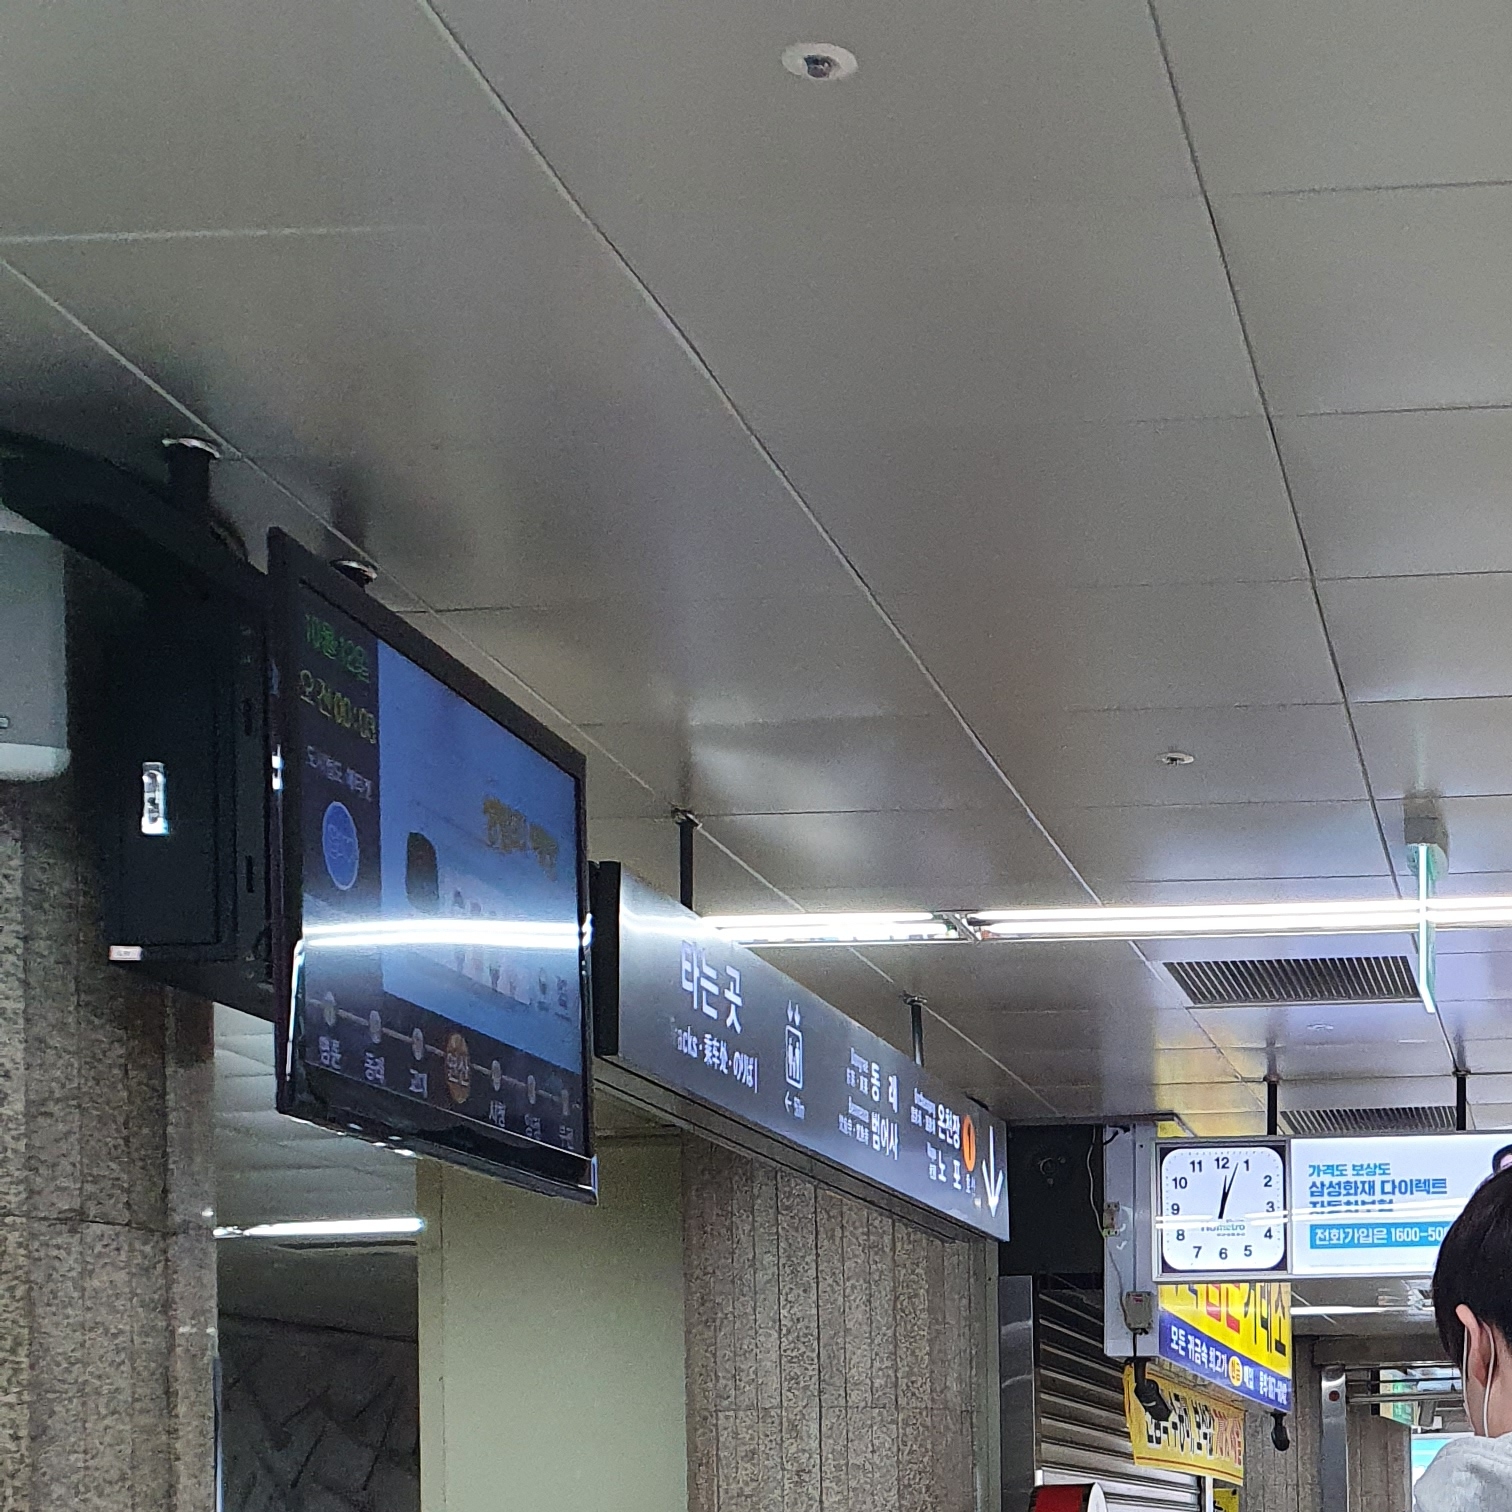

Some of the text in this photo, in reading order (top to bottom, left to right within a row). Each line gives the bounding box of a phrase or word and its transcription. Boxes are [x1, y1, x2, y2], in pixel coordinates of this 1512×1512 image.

[681, 940, 743, 1034] 타는 곳
[938, 1104, 961, 1149] 온천장
[871, 1111, 899, 1161] 범어사
[1190, 1156, 1250, 1173] 11 12 1
[1308, 1162, 1391, 1178] 가격도 보상도
[1172, 1175, 1273, 1190] 10 2
[1308, 1178, 1448, 1197] 삼성화재 다이렉트
[1171, 1200, 1275, 1216] 9 3
[1175, 1226, 1273, 1242] 8 4
[1315, 1228, 1388, 1246] 전화가입은
[1192, 1244, 1253, 1260] 7 6 5
[1170, 1325, 1186, 1357] 모든
[1187, 1335, 1209, 1370] 귀금속
